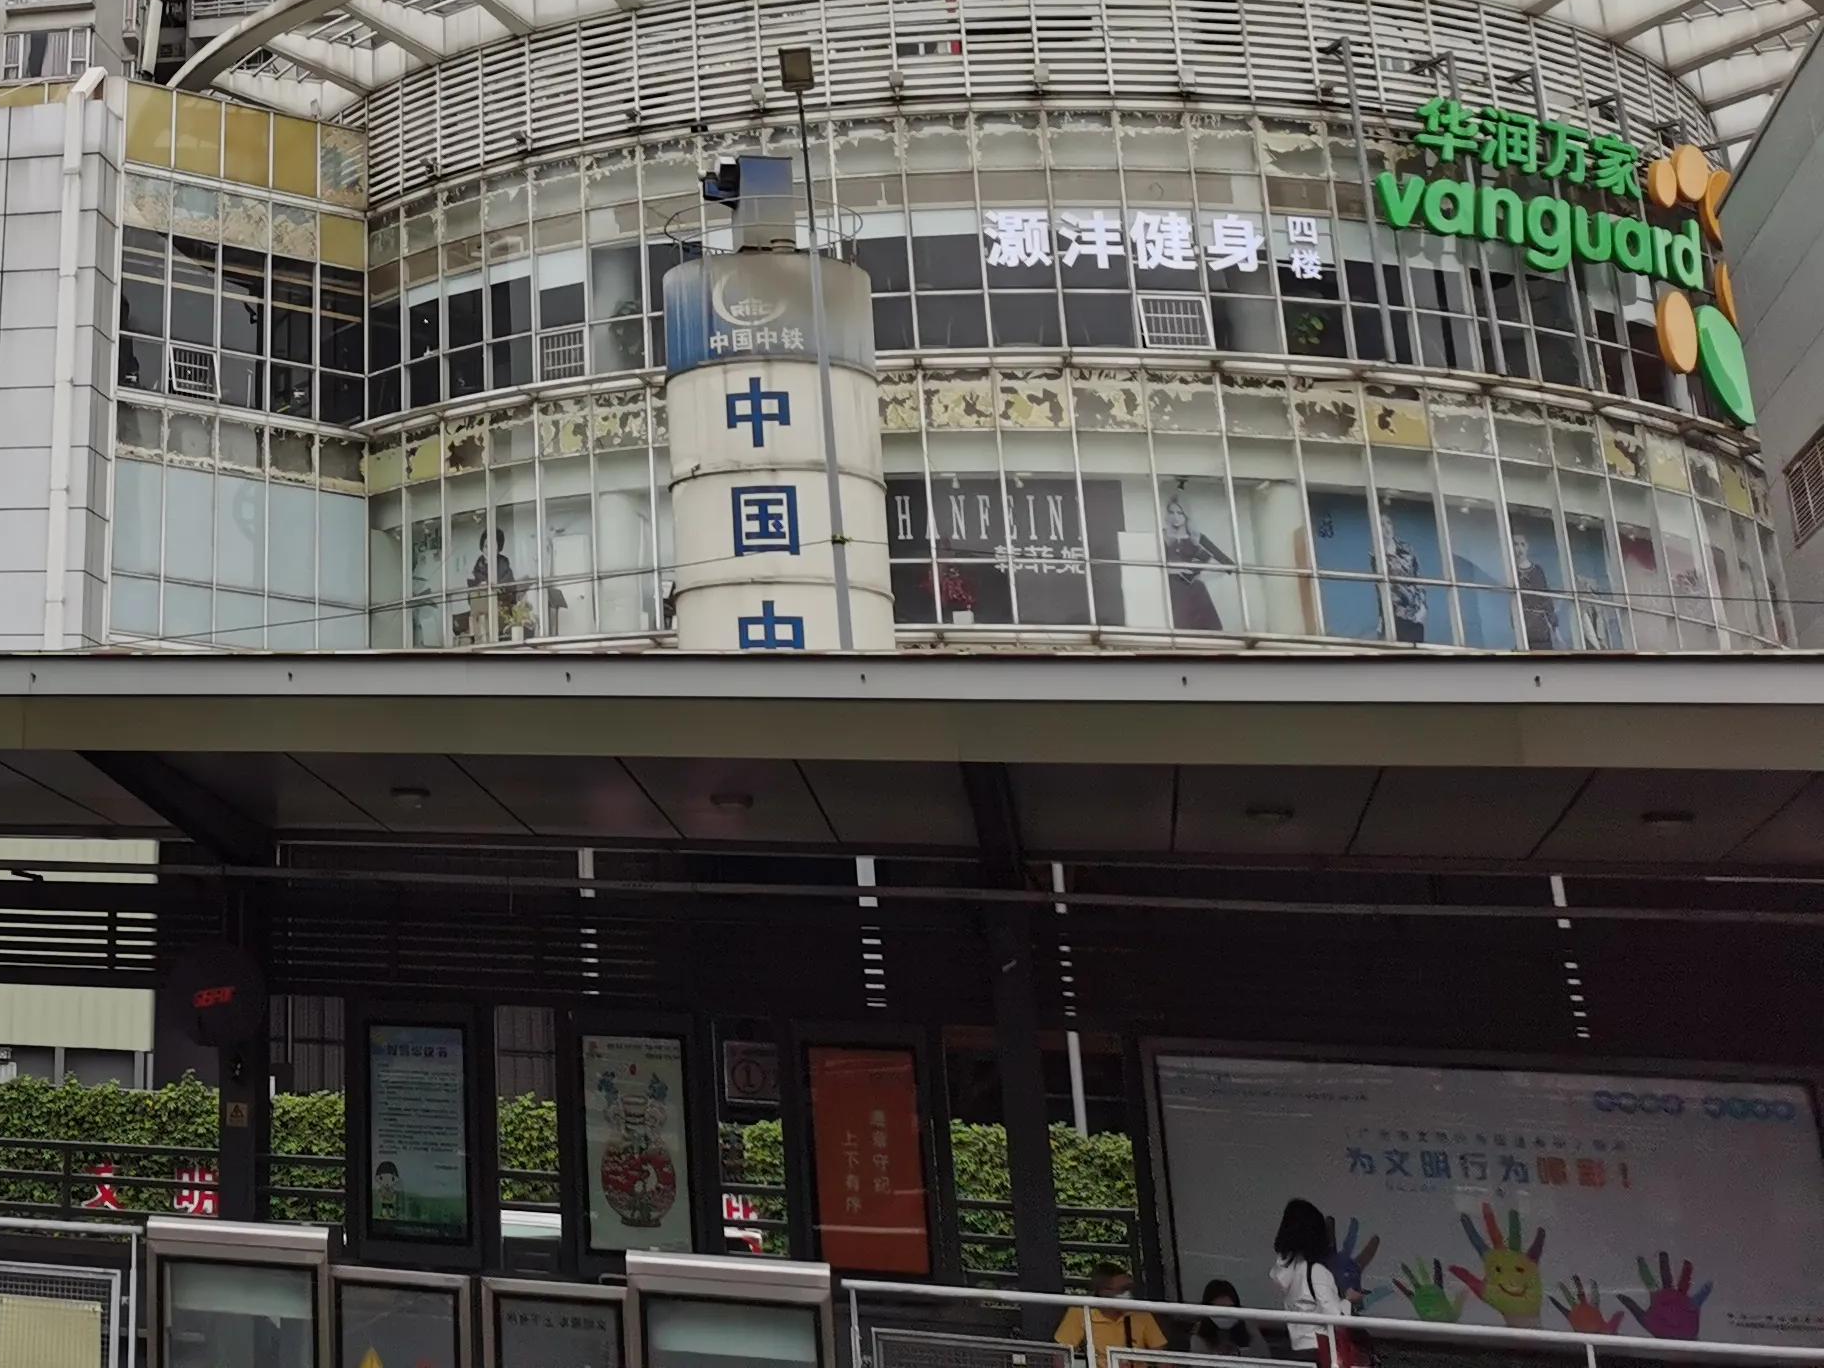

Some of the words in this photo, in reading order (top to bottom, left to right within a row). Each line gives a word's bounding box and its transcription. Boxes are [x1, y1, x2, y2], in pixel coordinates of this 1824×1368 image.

[1414, 96, 1643, 200] 华润万家
[983, 209, 1265, 273] 灏沣健身
[1288, 215, 1323, 281] 四楼
[1375, 171, 1704, 291] vanguard
[709, 326, 805, 355] 中国中铁
[79, 1158, 220, 1218] 文明
